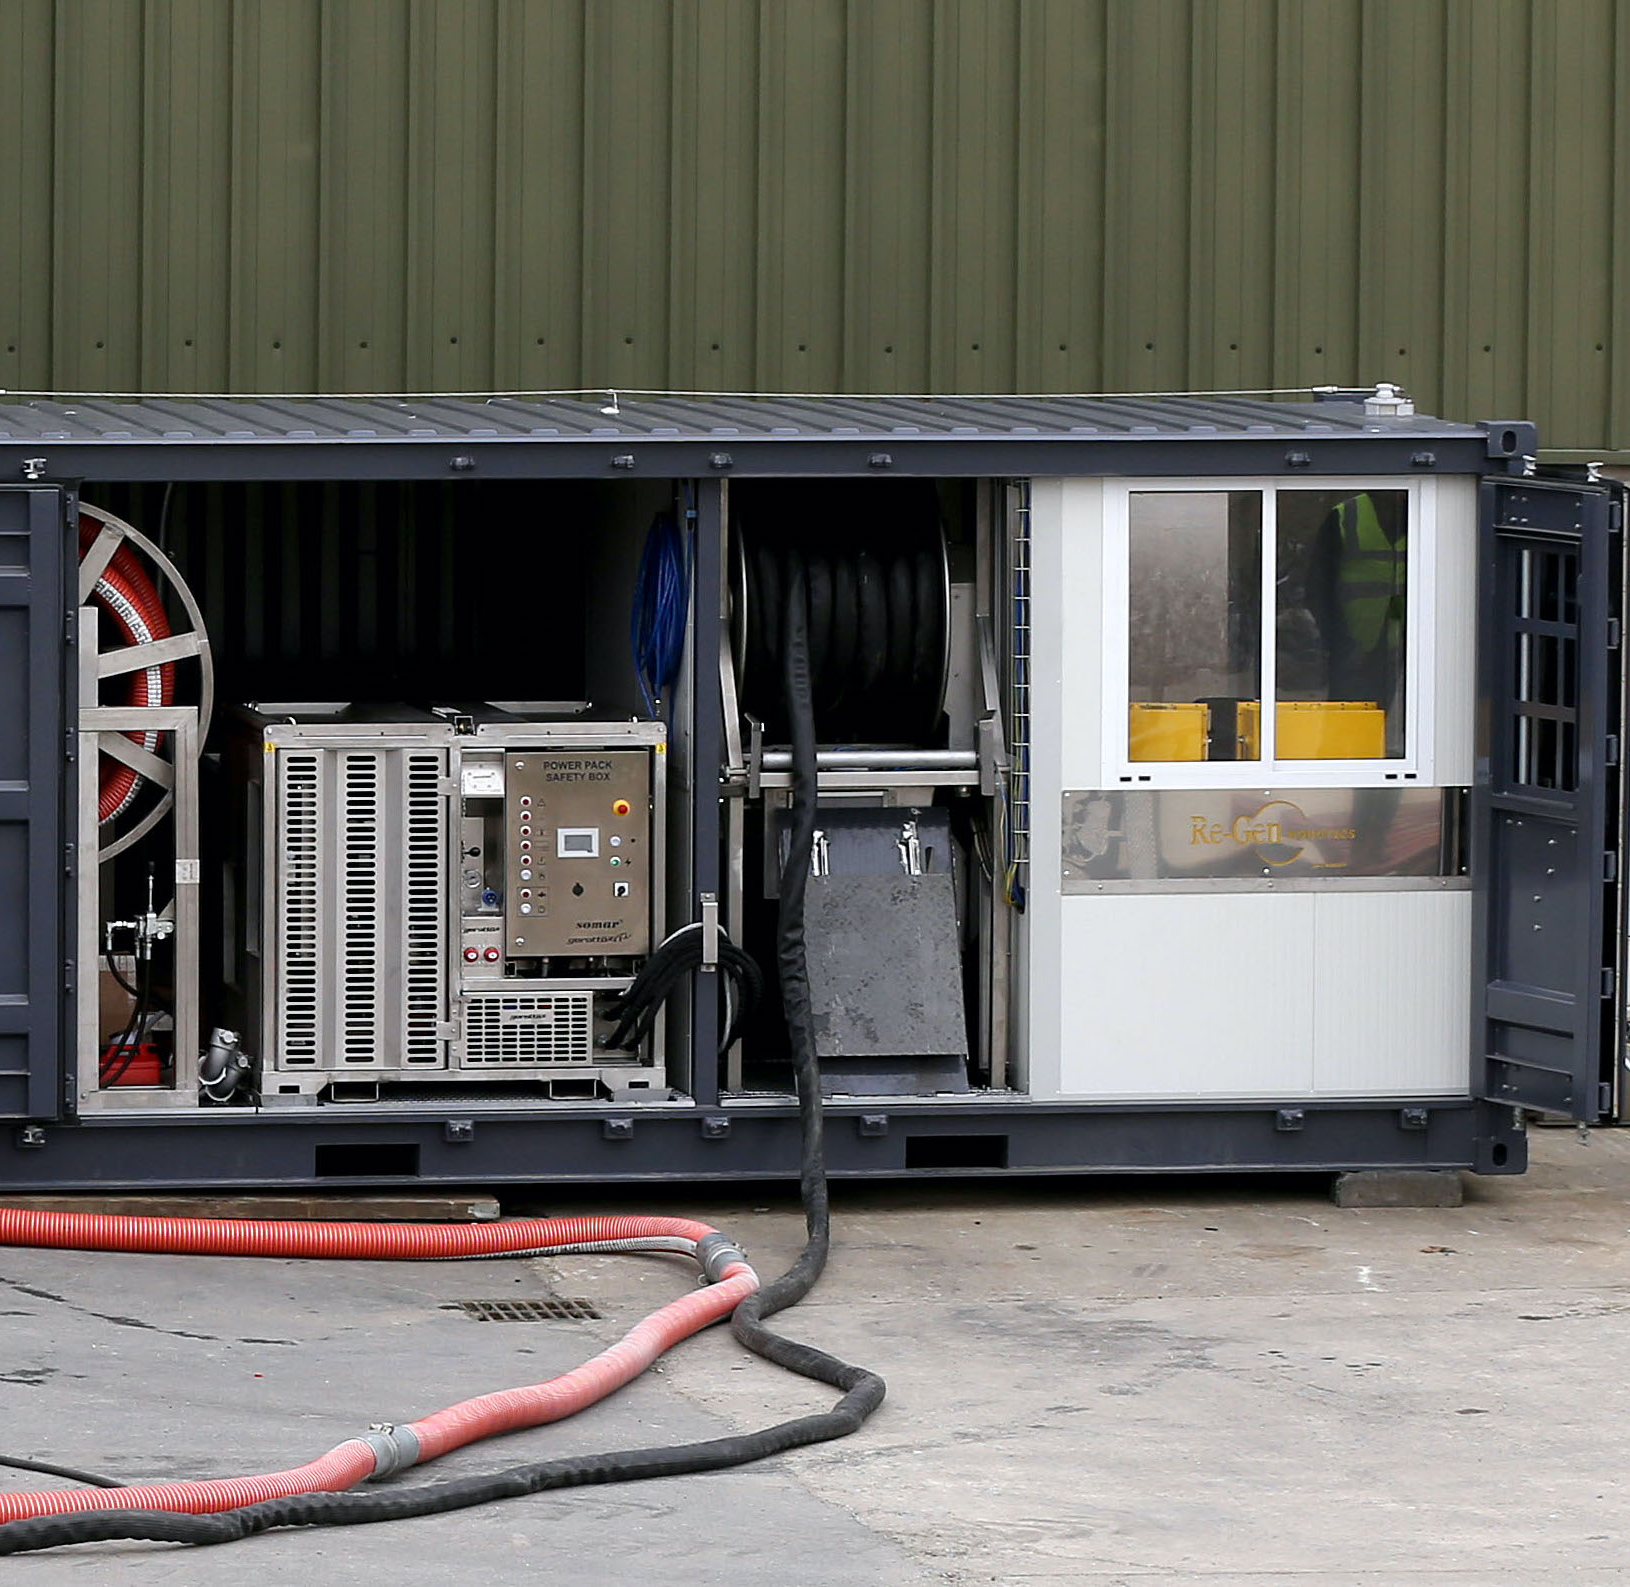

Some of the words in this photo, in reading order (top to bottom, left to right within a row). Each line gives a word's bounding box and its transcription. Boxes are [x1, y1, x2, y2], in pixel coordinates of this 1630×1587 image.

[543, 761, 582, 770] POWER
[584, 760, 612, 769] PACK
[545, 773, 586, 782] SAFETY
[588, 772, 611, 781] BOX
[1190, 815, 1283, 845] Re-Gen
[576, 921, 620, 929] somar
